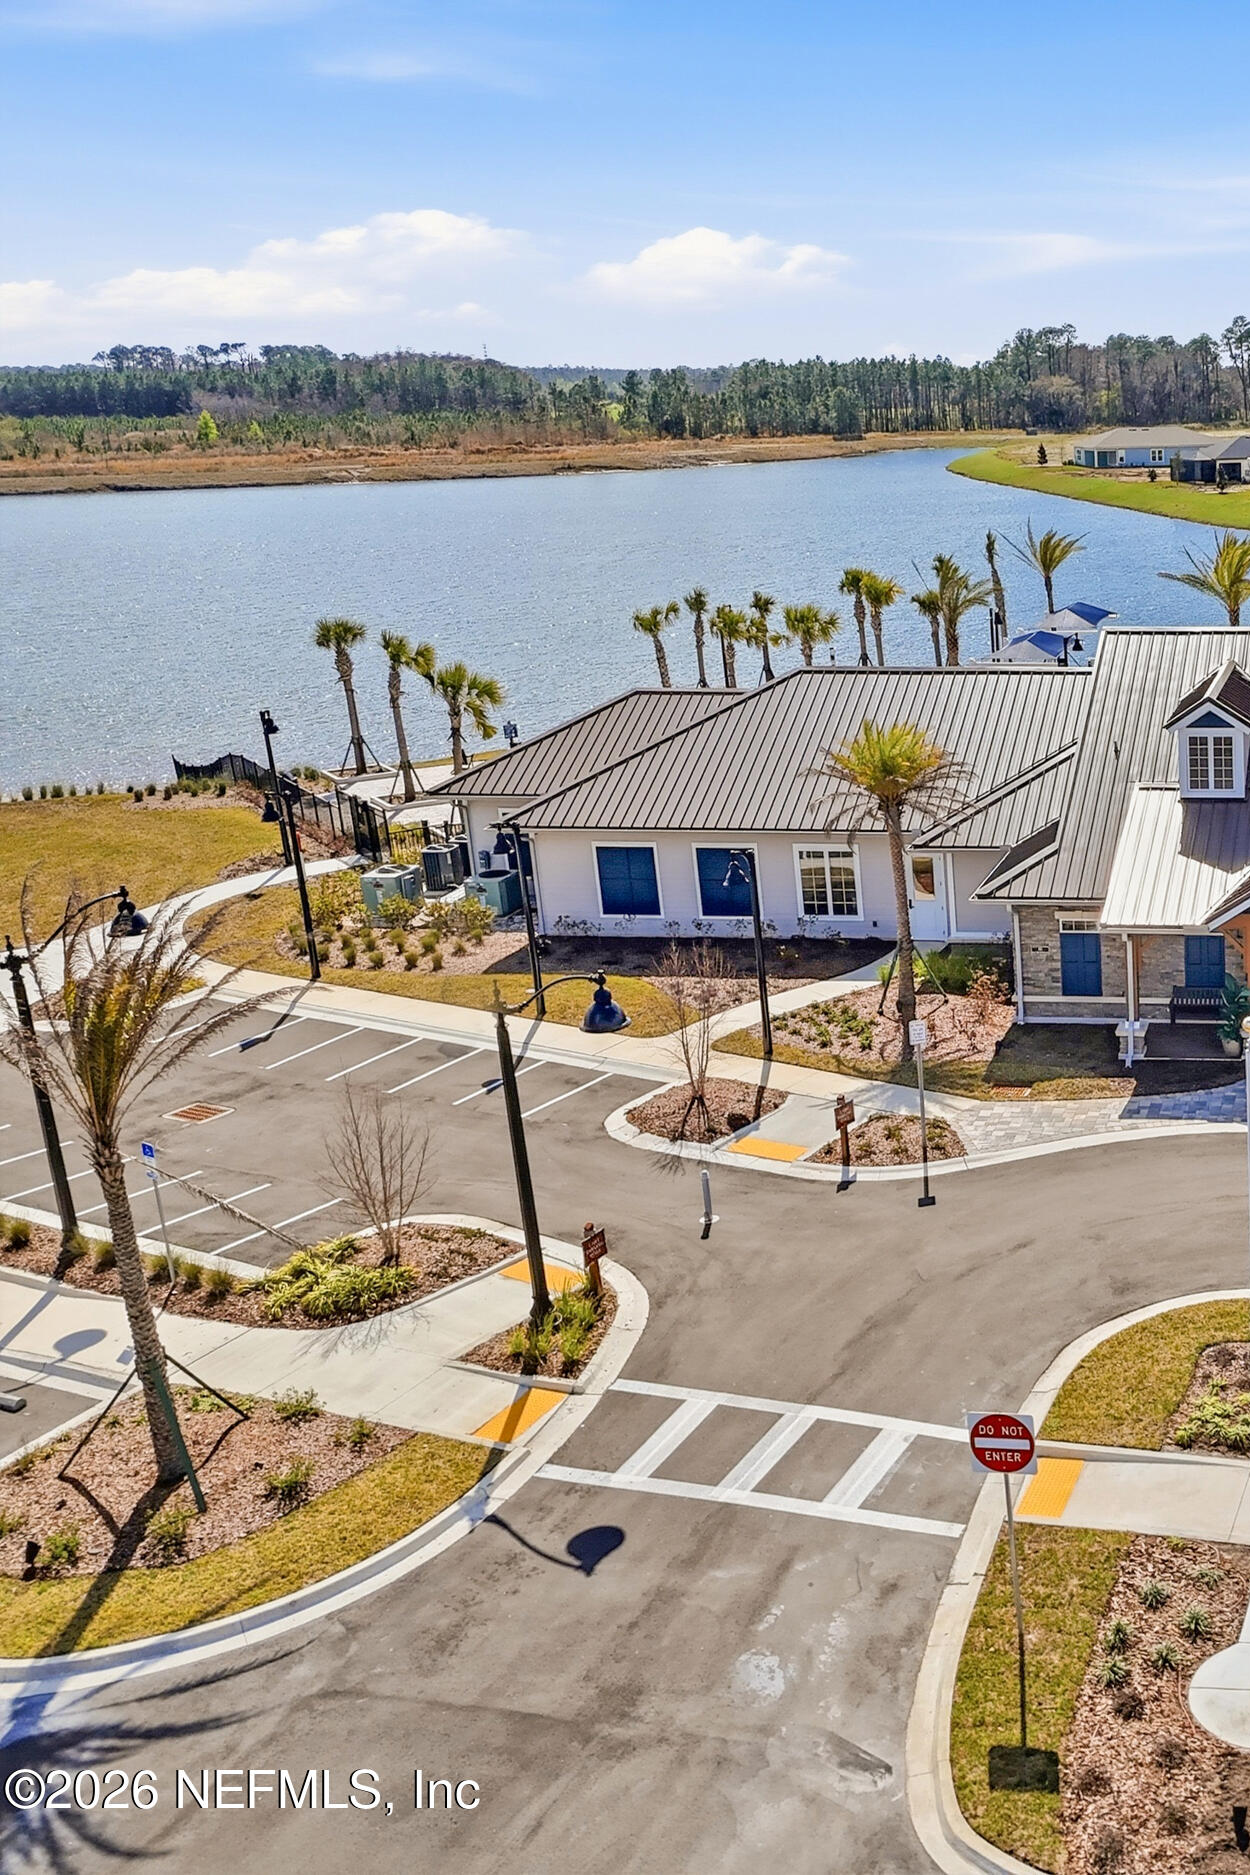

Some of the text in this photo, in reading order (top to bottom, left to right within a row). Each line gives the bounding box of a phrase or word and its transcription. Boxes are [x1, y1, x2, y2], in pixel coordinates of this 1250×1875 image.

[978, 1425, 1024, 1436] DO NOT
[985, 1451, 1021, 1462] ENTER
